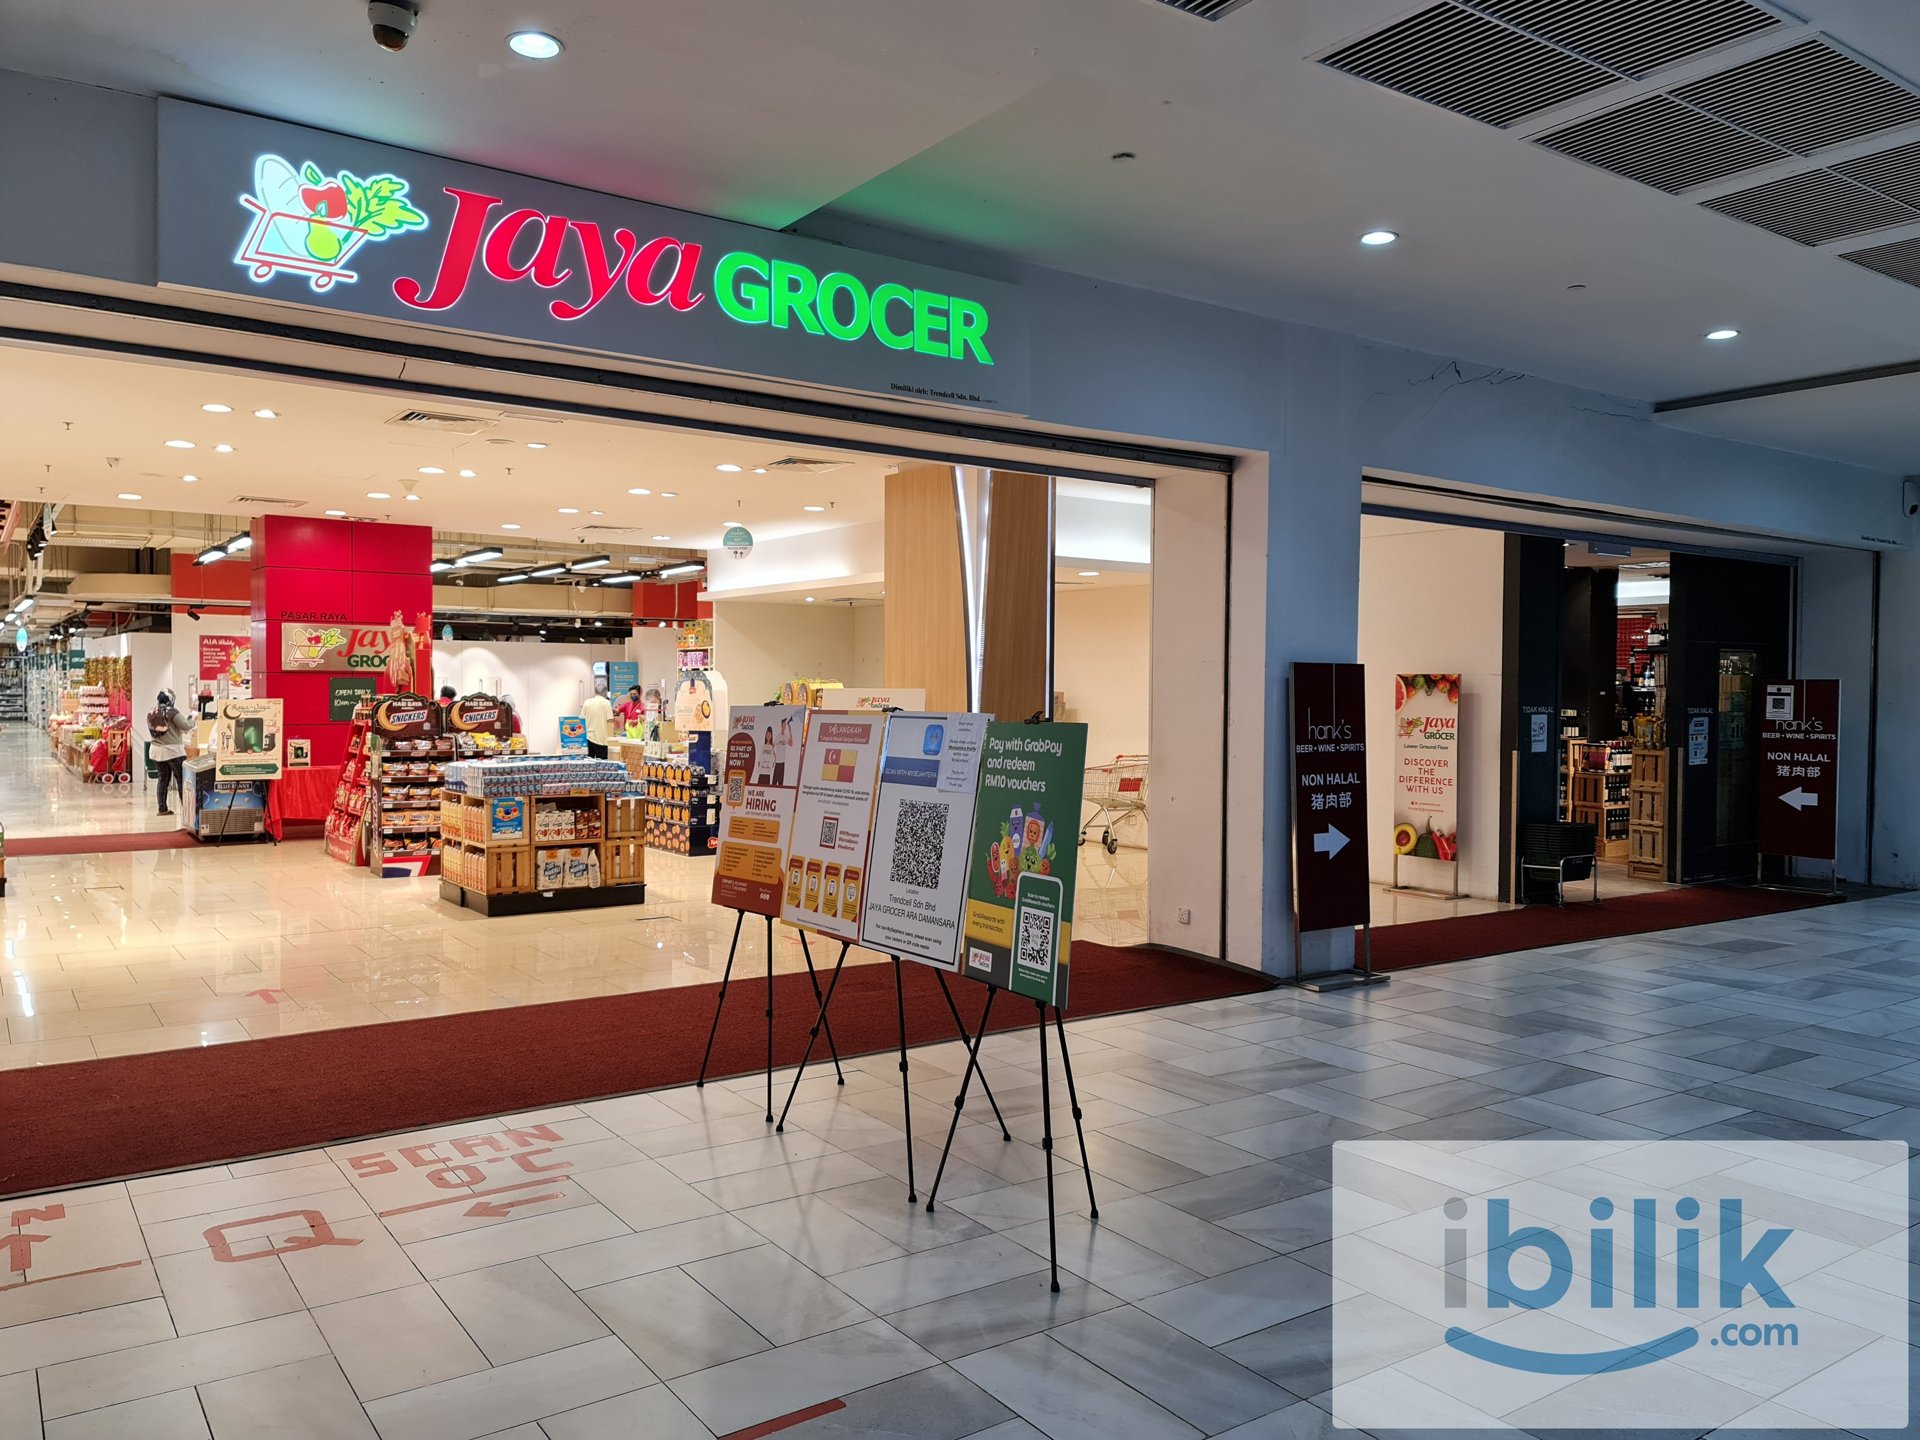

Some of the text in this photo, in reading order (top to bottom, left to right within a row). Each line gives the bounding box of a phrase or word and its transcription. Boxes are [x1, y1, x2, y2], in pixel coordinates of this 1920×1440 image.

[392, 187, 995, 366] Jaya GROCER
[281, 611, 347, 621] PASAR RAYA
[337, 629, 391, 658] Jay
[347, 654, 389, 668] GRO
[391, 711, 426, 724] SNICKERS
[463, 711, 497, 723] SNICKERS
[1419, 717, 1456, 733] Jaya
[1424, 732, 1455, 740] GROCER
[989, 737, 1062, 757] Pay with GrabPay
[1296, 743, 1364, 753] BEER WINE SPIRITS
[987, 755, 1035, 771] and redeem
[1404, 758, 1448, 767] DISCOVER
[1767, 752, 1831, 762] NON HALAL
[1418, 767, 1435, 776] THE
[1776, 765, 1821, 778] 猪肉部
[985, 774, 1006, 788] RM10
[1007, 777, 1046, 792] vouchers
[1301, 772, 1360, 786] NON HALAL
[1399, 775, 1453, 786] DIFFERENCE
[1406, 784, 1443, 795] WITH US
[746, 798, 777, 812] HIRING
[1311, 792, 1352, 810] 猪肉部
[889, 894, 936, 911] Trendcell Sdn Bhd
[868, 902, 955, 929] JAYA GROCER ARA DAMANSARA
[346, 1124, 564, 1178] SCAN
[202, 1209, 365, 1263] Q
